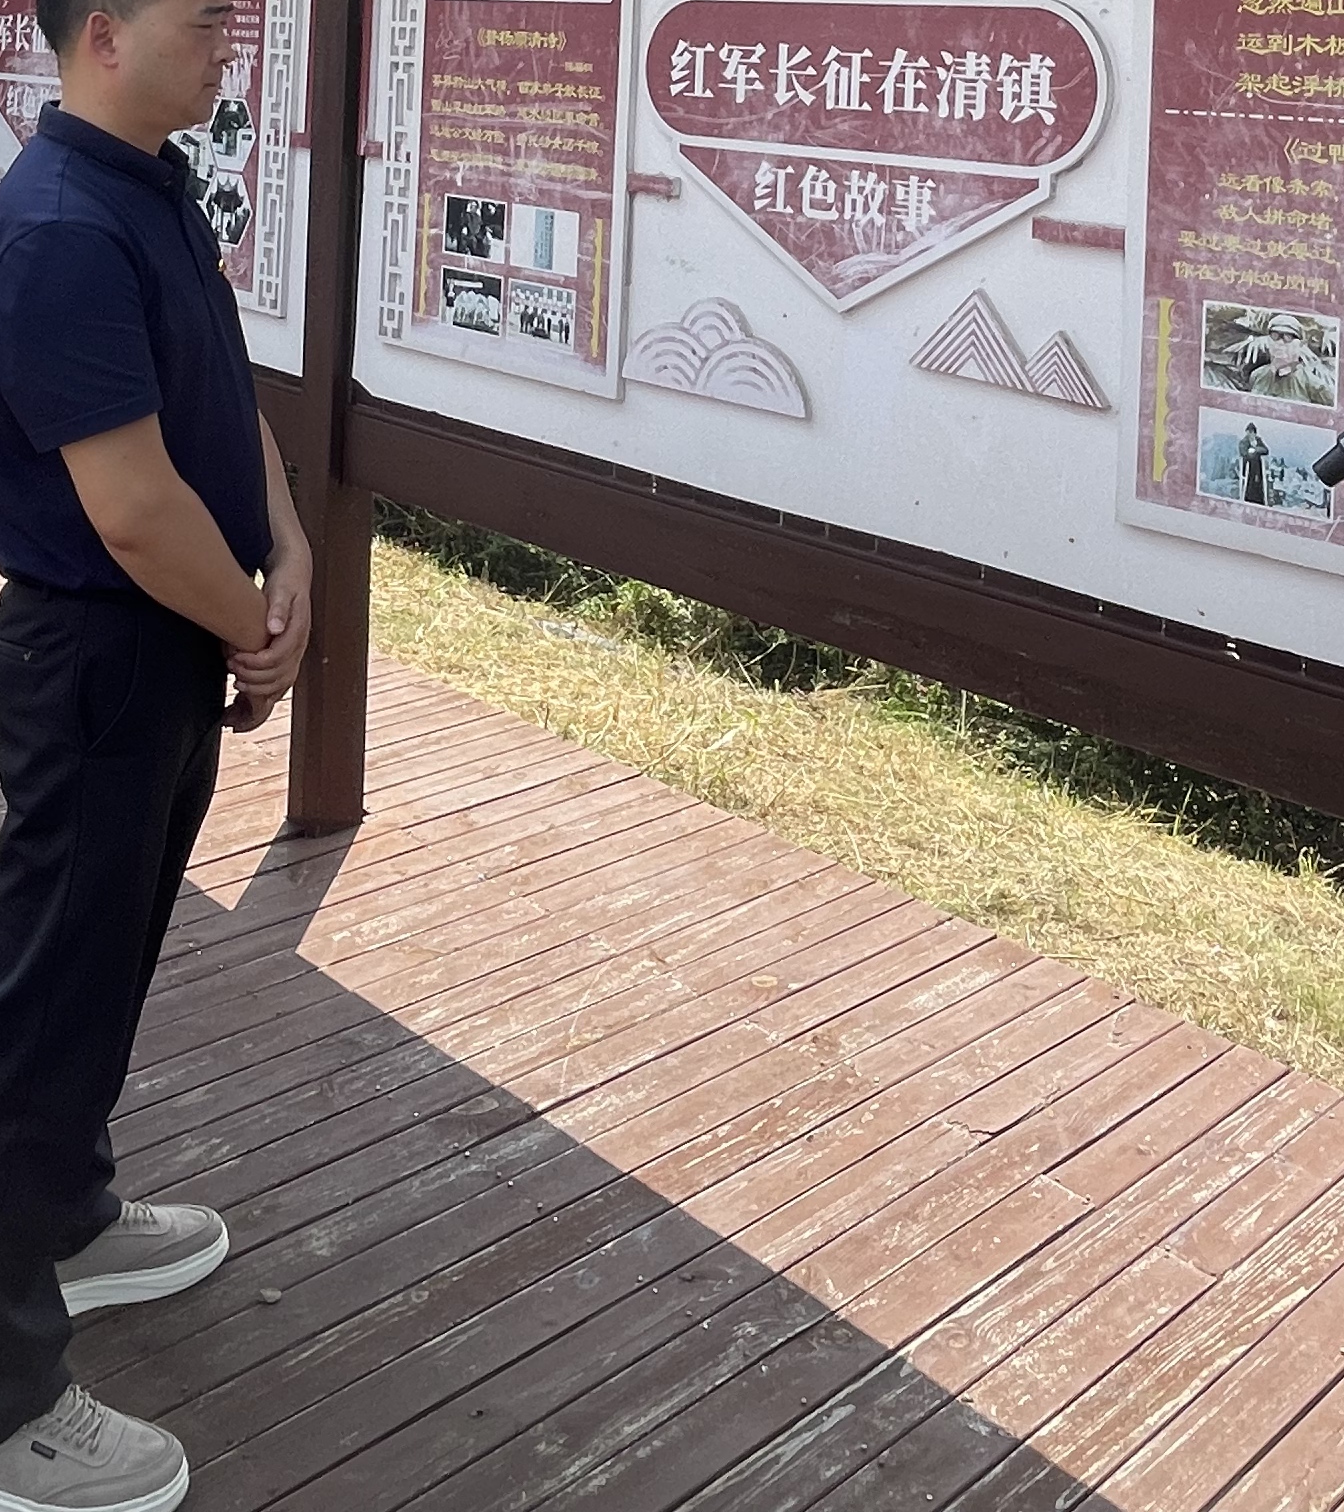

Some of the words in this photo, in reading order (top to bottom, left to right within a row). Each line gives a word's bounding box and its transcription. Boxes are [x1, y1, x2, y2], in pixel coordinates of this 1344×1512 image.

[669, 38, 1059, 126] 红军长征在清镇
[752, 159, 939, 233] 红色故事
